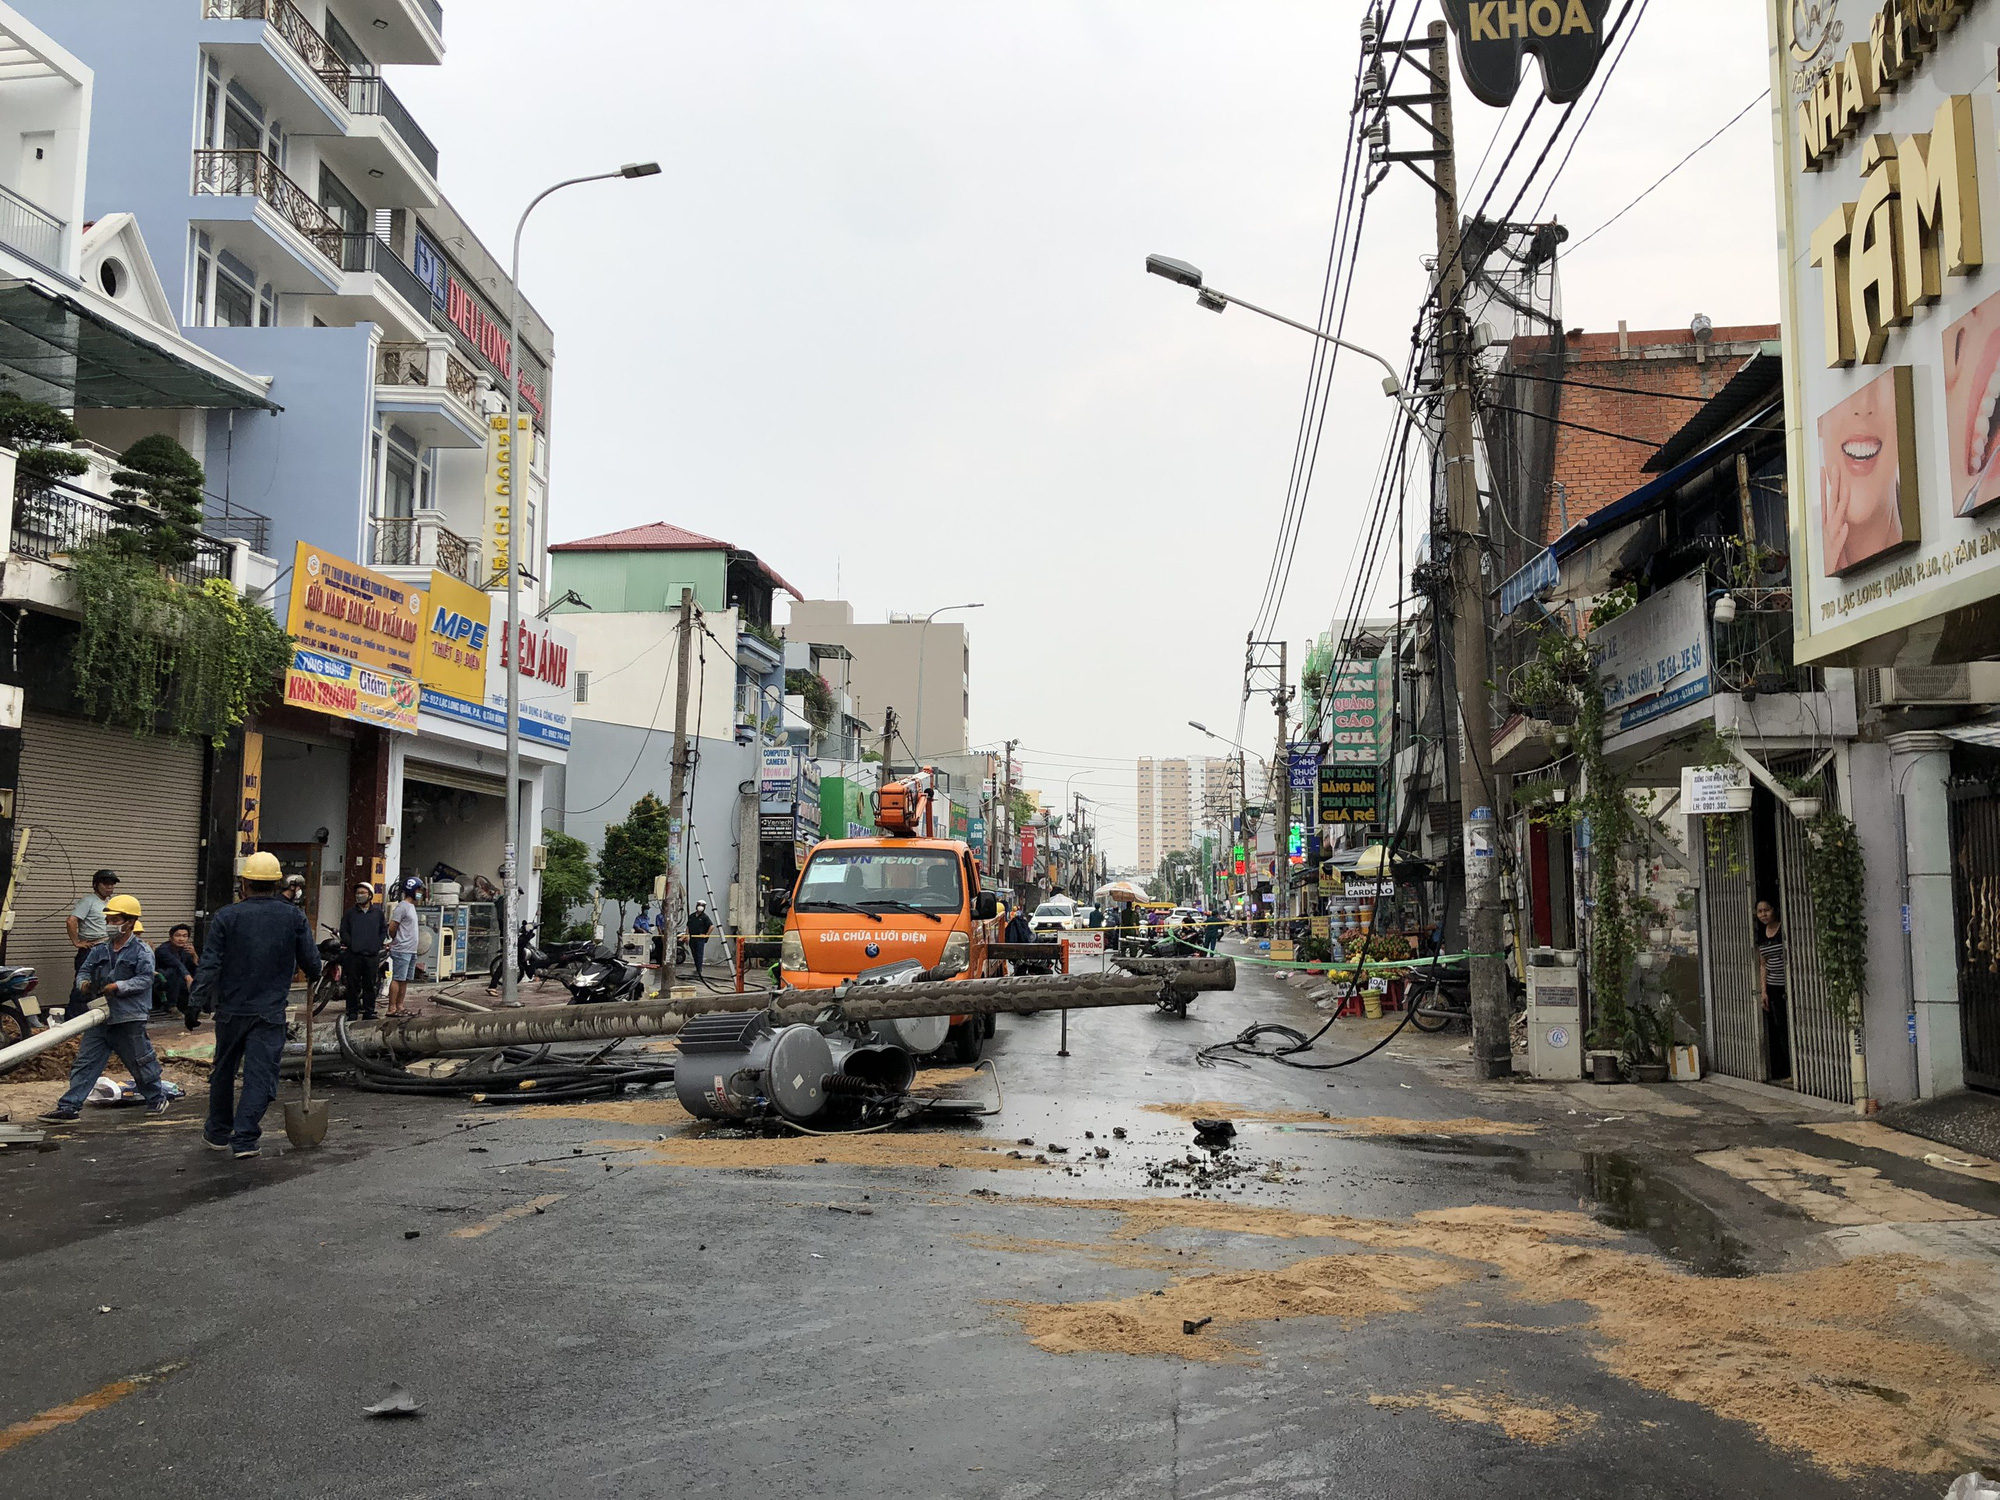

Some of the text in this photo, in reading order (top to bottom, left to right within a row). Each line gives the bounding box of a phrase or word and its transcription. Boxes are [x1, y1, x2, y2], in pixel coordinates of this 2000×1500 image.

[1468, 0, 1595, 41] KHOA
[1799, 42, 1872, 173] NHA
[1810, 93, 1975, 370] TÂM
[480, 312, 511, 381] LONG
[1837, 591, 1856, 617] LẠC
[1857, 580, 1882, 606] LONG
[1884, 565, 1916, 598] QUÂN,
[1916, 556, 1942, 584] P.10,
[1942, 551, 1954, 575] Q.
[1953, 539, 1978, 566] TÂN
[305, 579, 323, 612] CỬA
[323, 589, 347, 620] HÀNG
[346, 596, 364, 625] BÁN
[363, 600, 381, 631] SẢN
[380, 606, 402, 638] PHẨM
[401, 618, 418, 643] ONG
[431, 607, 488, 650] MPE
[432, 640, 481, 671] THIẾT BỊ ĐIỆN
[536, 629, 568, 688] ÁNH
[1657, 658, 1667, 684] XE
[1667, 654, 1677, 679] GA
[1681, 647, 1691, 672] XE
[1692, 632, 1702, 669] SỐ
[1335, 661, 1373, 674] IN
[288, 676, 316, 703] KHAI
[359, 670, 388, 697] Giảm
[1335, 676, 1375, 691] ẤN
[430, 694, 439, 705] 912
[439, 697, 448, 708] LẠC
[448, 700, 459, 711] LONG
[1334, 693, 1375, 712] QUẢNG
[1335, 713, 1375, 727] CÁO
[1335, 729, 1376, 744] GIÁ
[763, 749, 790, 757] COMPUTER
[1298, 757, 1315, 766] NHÀ
[766, 758, 787, 766] CAMERA
[1293, 766, 1316, 776] THUỐ
[1321, 769, 1375, 778] IN DECAL
[1293, 777, 1306, 785] GIÁ
[1321, 780, 1375, 793] BĂNG RÔN
[1322, 796, 1343, 807] TEM
[1322, 808, 1350, 821] GIÁ
[820, 930, 927, 944] SỬA CHỮA LƯỚI ĐIỆN
[706, 1092, 722, 1111] 100
